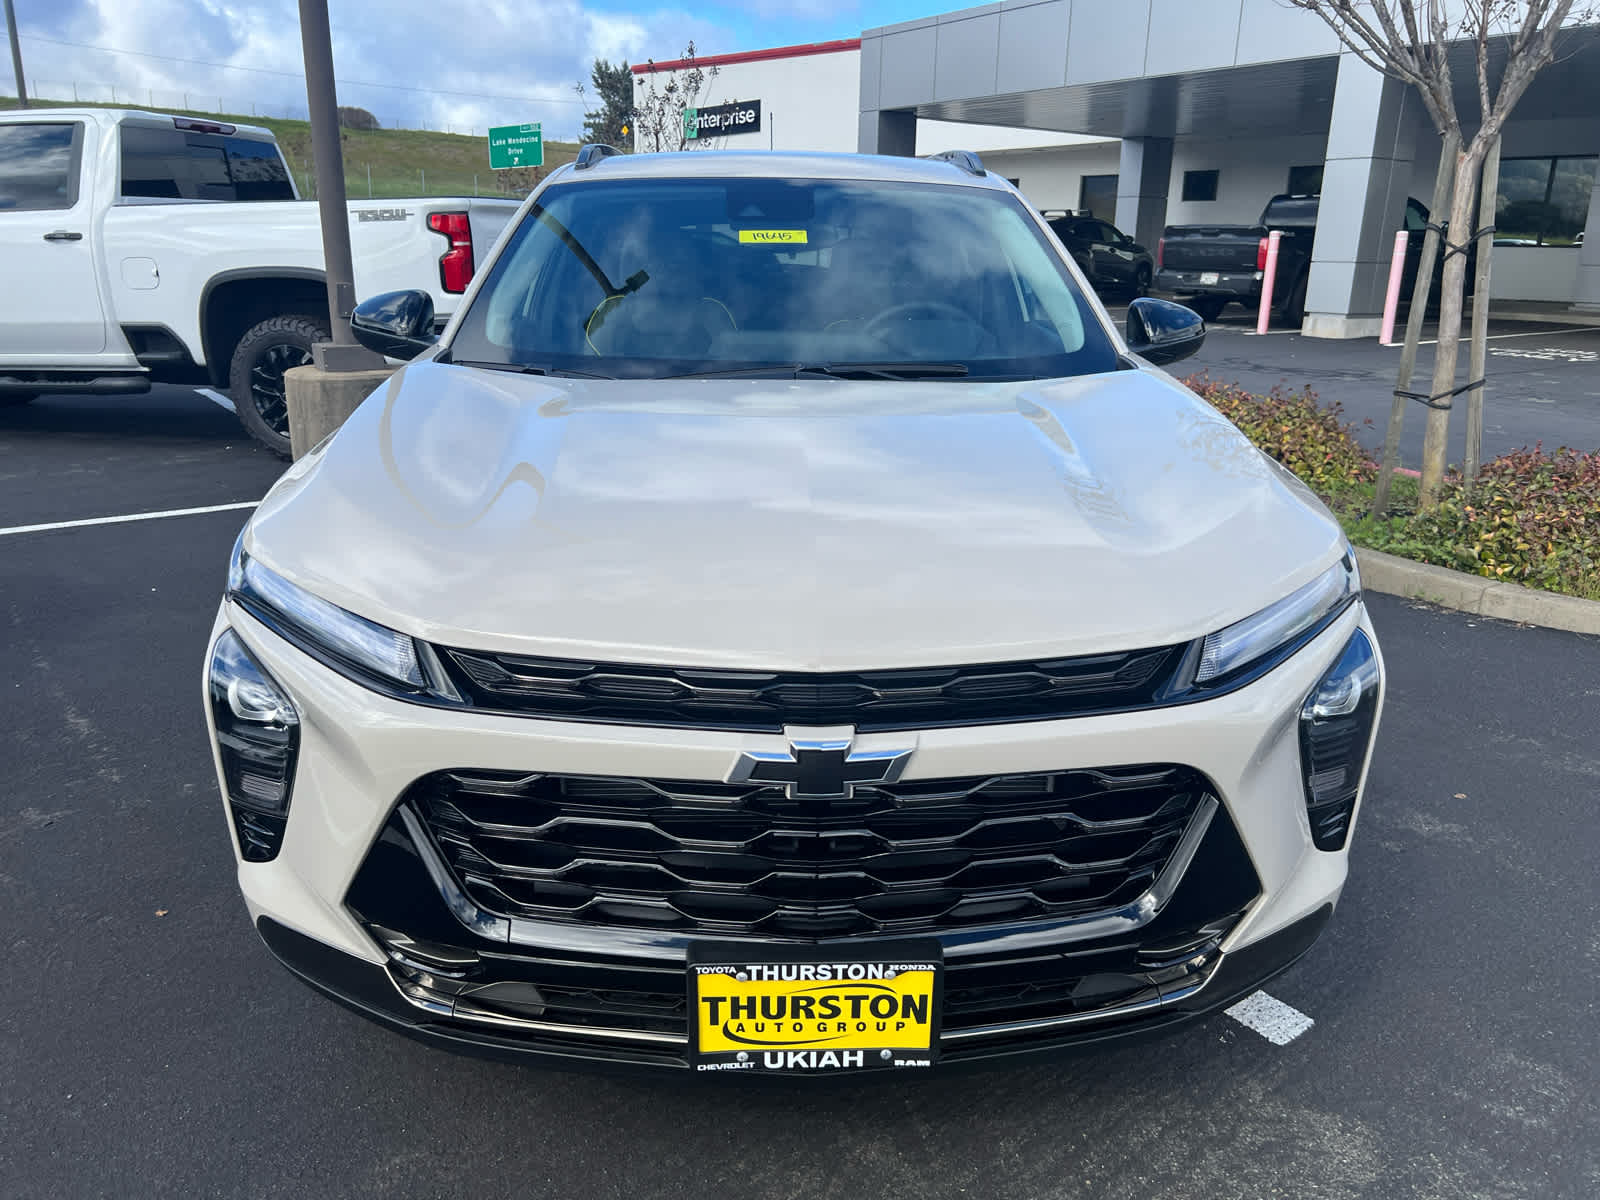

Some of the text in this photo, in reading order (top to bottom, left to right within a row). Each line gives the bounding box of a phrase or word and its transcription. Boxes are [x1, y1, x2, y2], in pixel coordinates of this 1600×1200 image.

[492, 138, 506, 146] Lake
[695, 966, 737, 974] TOYOTA
[746, 964, 884, 981] THURSTON
[701, 994, 928, 1026] THURSTON
[763, 1050, 864, 1069] UKIAH
[894, 1059, 931, 1067] RAM
[697, 1061, 756, 1071] CHEVROLET
